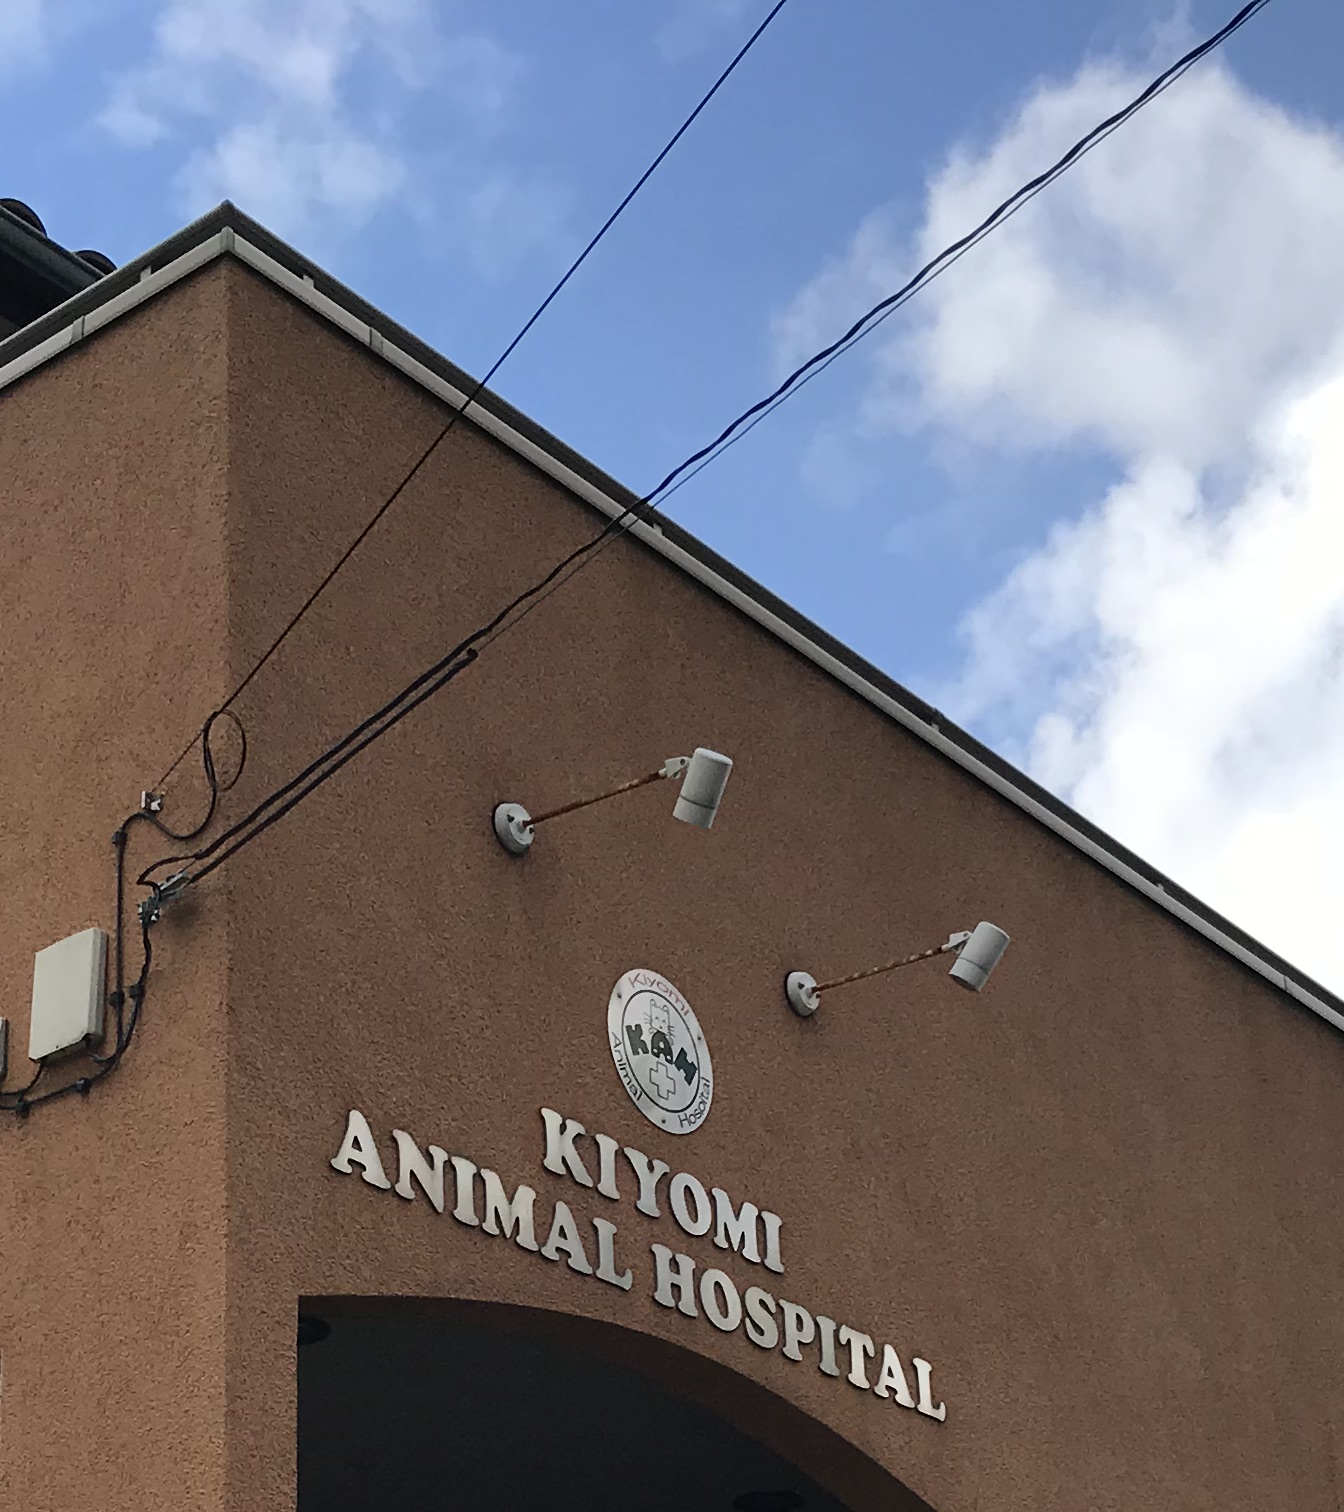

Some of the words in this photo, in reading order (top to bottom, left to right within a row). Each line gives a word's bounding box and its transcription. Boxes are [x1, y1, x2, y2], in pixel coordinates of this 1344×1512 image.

[628, 972, 690, 1017] Kiyomi
[611, 1031, 643, 1102] Animal
[677, 1076, 711, 1128] Hospital
[540, 1107, 785, 1274] KIYOMI
[330, 1109, 634, 1291] ANIMAL
[651, 1243, 947, 1422] HOSPITAL
